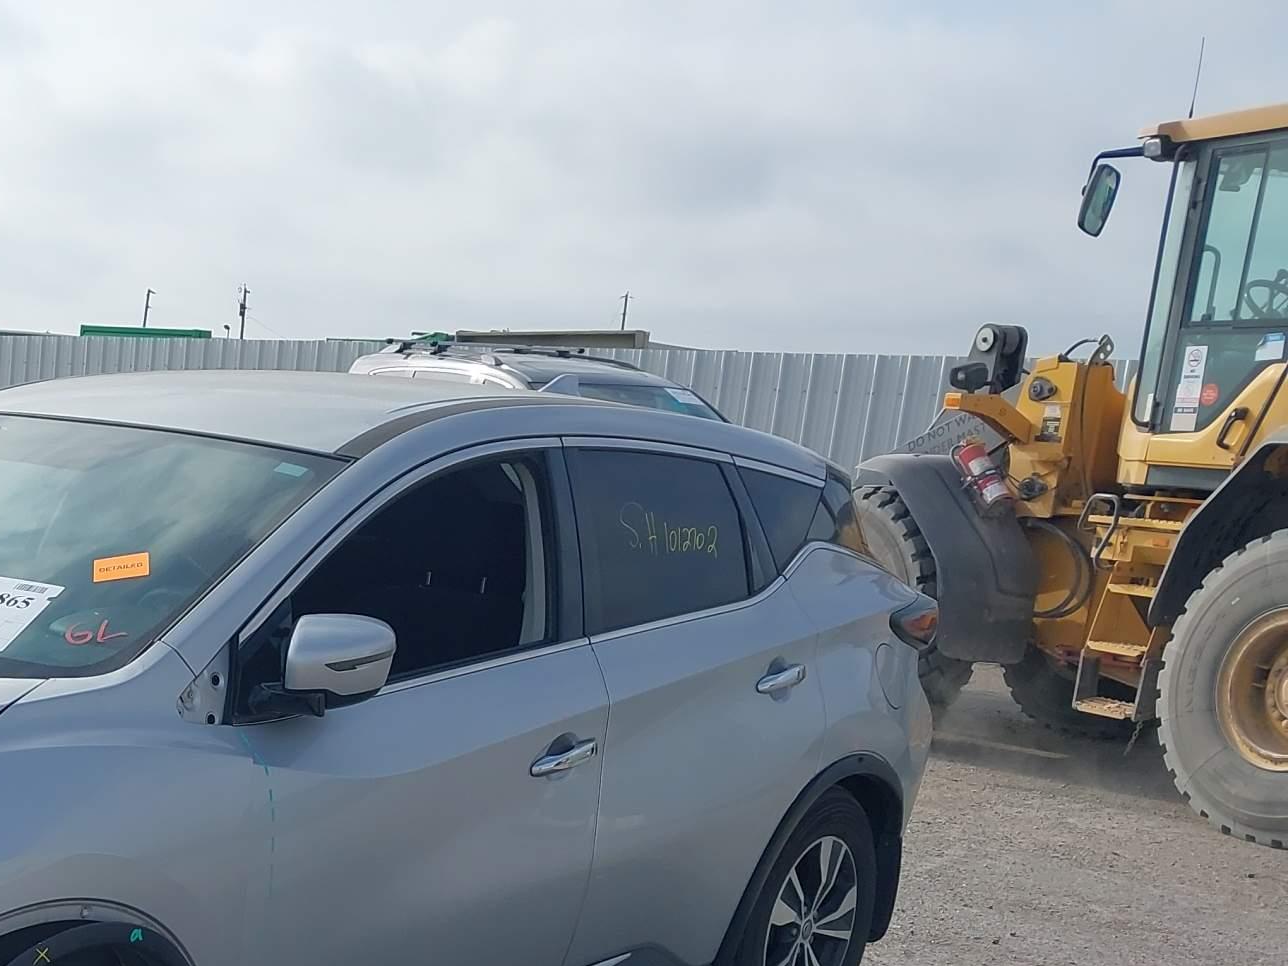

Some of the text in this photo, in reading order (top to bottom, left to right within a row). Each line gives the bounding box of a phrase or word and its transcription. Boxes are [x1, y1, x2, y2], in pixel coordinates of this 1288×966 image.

[907, 436, 925, 451] DO
[927, 422, 952, 440] NOT
[98, 561, 144, 574] DETAILED
